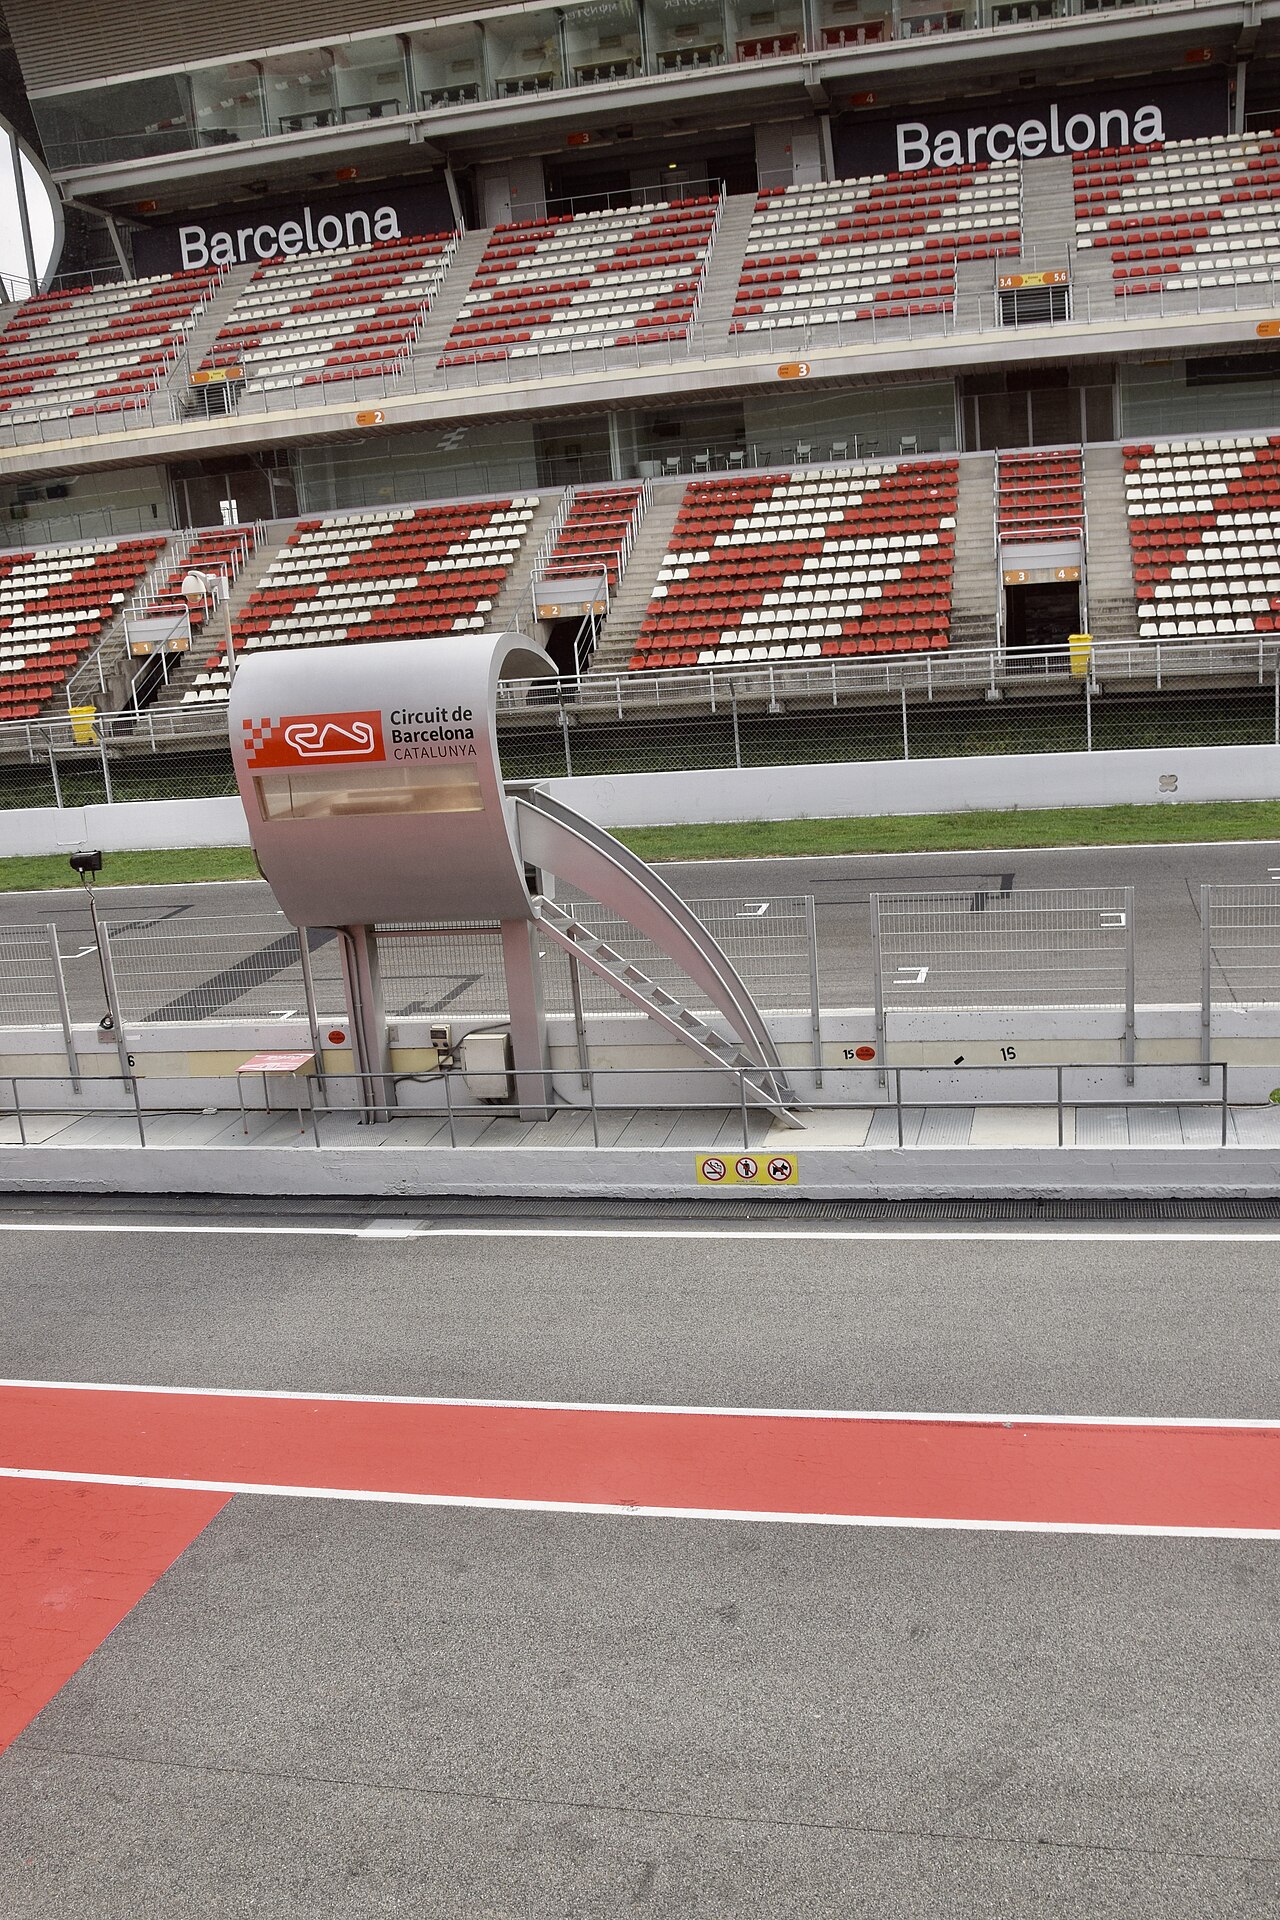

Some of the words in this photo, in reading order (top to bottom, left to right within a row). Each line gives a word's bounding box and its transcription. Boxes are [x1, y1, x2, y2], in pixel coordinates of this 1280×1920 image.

[1203, 49, 1211, 60] 5
[866, 93, 874, 103] 4
[582, 133, 590, 143] 3
[896, 103, 1166, 171] Barcelona
[351, 168, 357, 178] 2
[151, 200, 156, 210] 1
[178, 206, 402, 271] Barcelona
[1000, 278, 1012, 287] 3.4
[1054, 272, 1067, 282] 5.6
[238, 368, 244, 376] 2
[798, 363, 807, 377] 3
[374, 411, 383, 423] 2
[1018, 572, 1026, 581] 3
[1058, 569, 1066, 579] 4
[551, 606, 559, 615] 2
[143, 643, 149, 652] 1
[172, 641, 178, 649] 2
[390, 706, 449, 725] Circuit
[451, 705, 473, 722] de
[391, 725, 475, 743] Barcelona
[393, 744, 477, 760] CATALUNYA
[842, 1049, 855, 1060] 15
